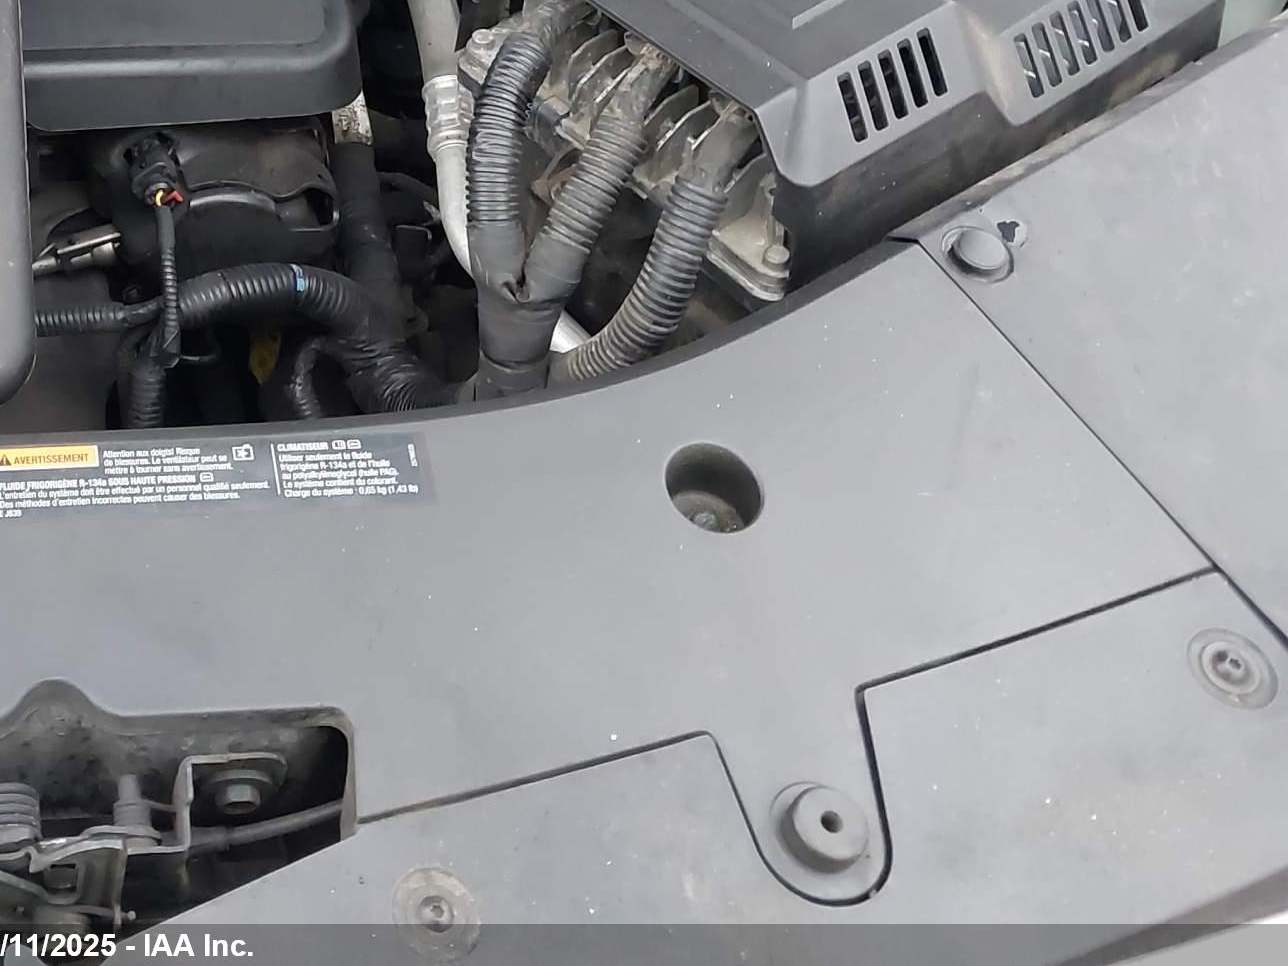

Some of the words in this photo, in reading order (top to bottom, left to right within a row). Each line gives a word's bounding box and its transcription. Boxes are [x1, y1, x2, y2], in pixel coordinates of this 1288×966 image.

[14, 453, 88, 464] AVERTISSEMENT
[130, 476, 156, 485] HAUTE
[156, 474, 196, 484] PRESSION
